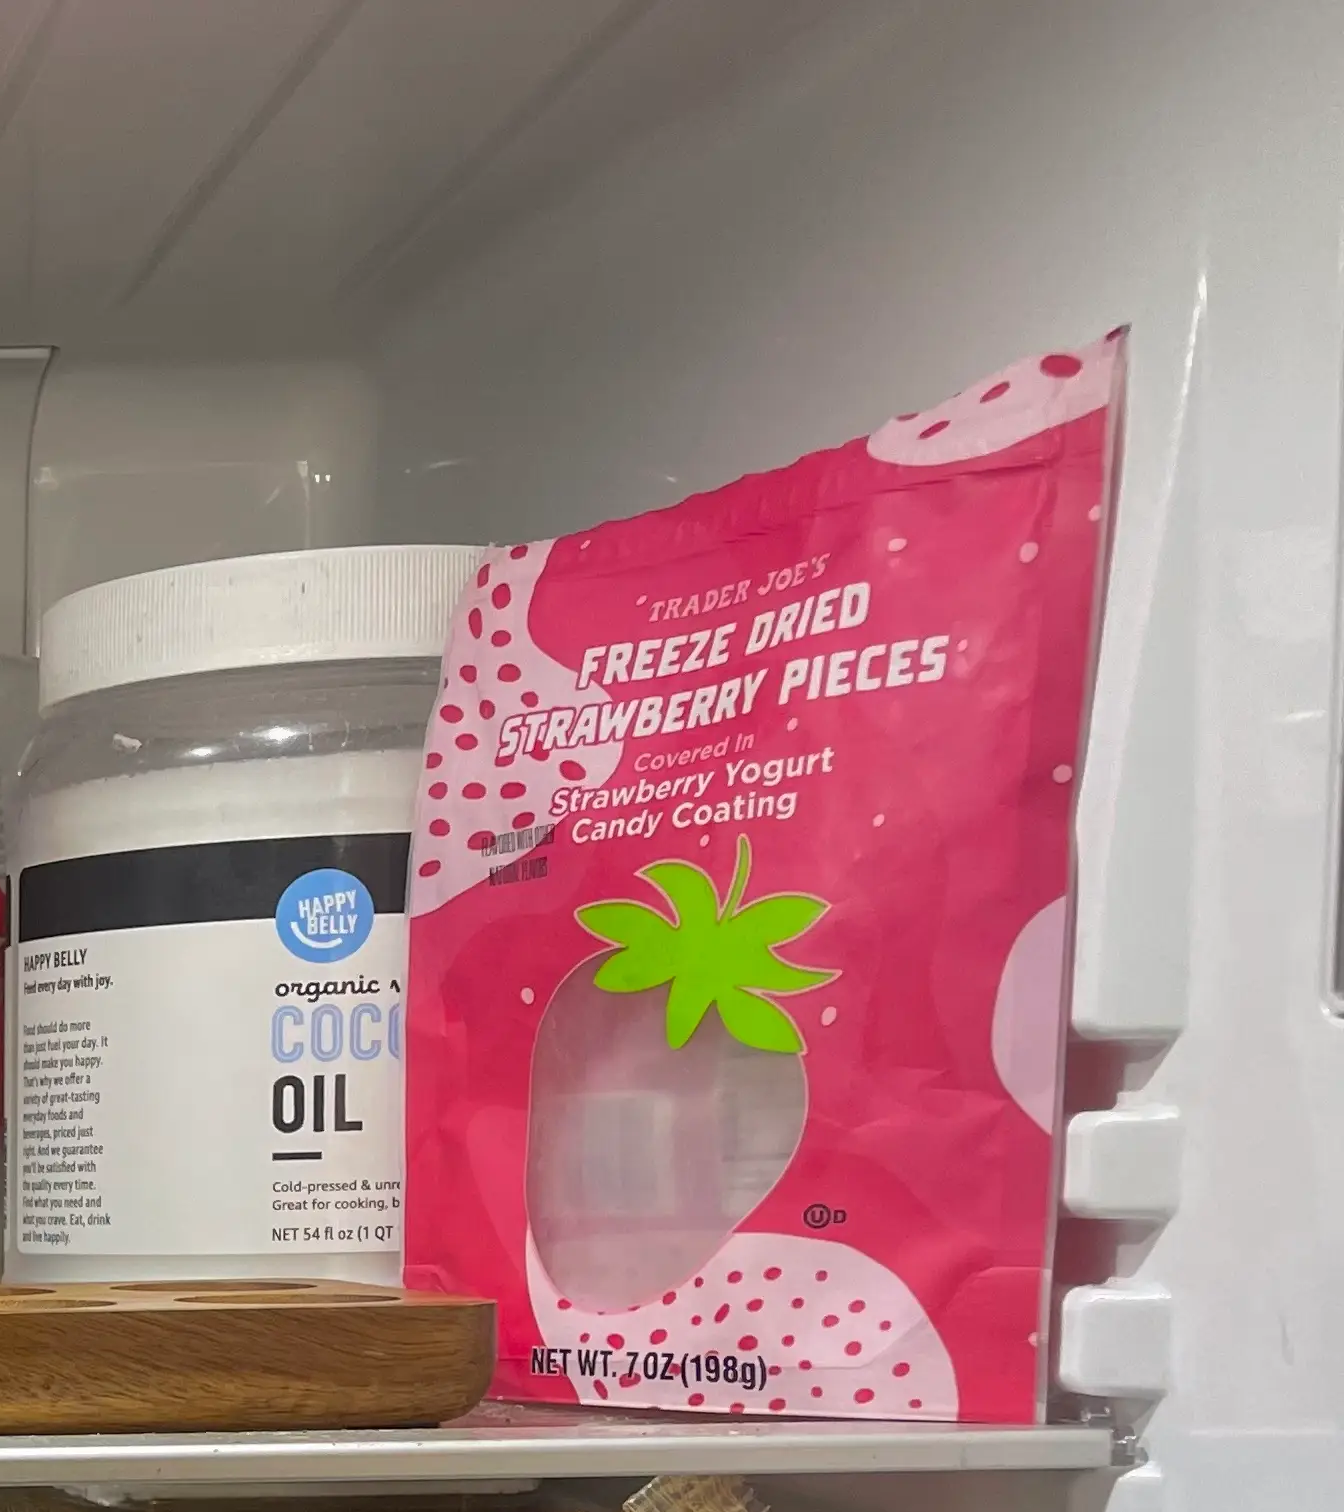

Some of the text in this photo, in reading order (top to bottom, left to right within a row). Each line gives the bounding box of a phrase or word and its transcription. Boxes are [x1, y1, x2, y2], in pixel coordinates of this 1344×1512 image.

[648, 553, 832, 623] TRADER JOE'S
[575, 580, 871, 691] FREEZE DRIED
[495, 634, 951, 760] STRAWBERRY PIECES
[633, 733, 755, 774] Covered In
[550, 746, 836, 817] Strawberry Yogurt
[571, 789, 798, 846] Candy Coating
[297, 889, 357, 919] HAPPY
[307, 914, 358, 936] BELLY
[23, 948, 88, 973] HAPPY BELLY
[73, 972, 114, 991] with joy.
[274, 973, 381, 1003] organic
[271, 1073, 363, 1135] OIL
[61, 1144, 104, 1159] guarantee
[272, 1179, 358, 1195] Cold-pressed
[87, 1213, 112, 1226] drink
[272, 1197, 389, 1212] Great for cooking,
[272, 1225, 394, 1242] NET 54 fl oz (1 QT
[531, 1347, 572, 1376] NET
[577, 1348, 618, 1378] WT.
[679, 1354, 767, 1391] (198g)
